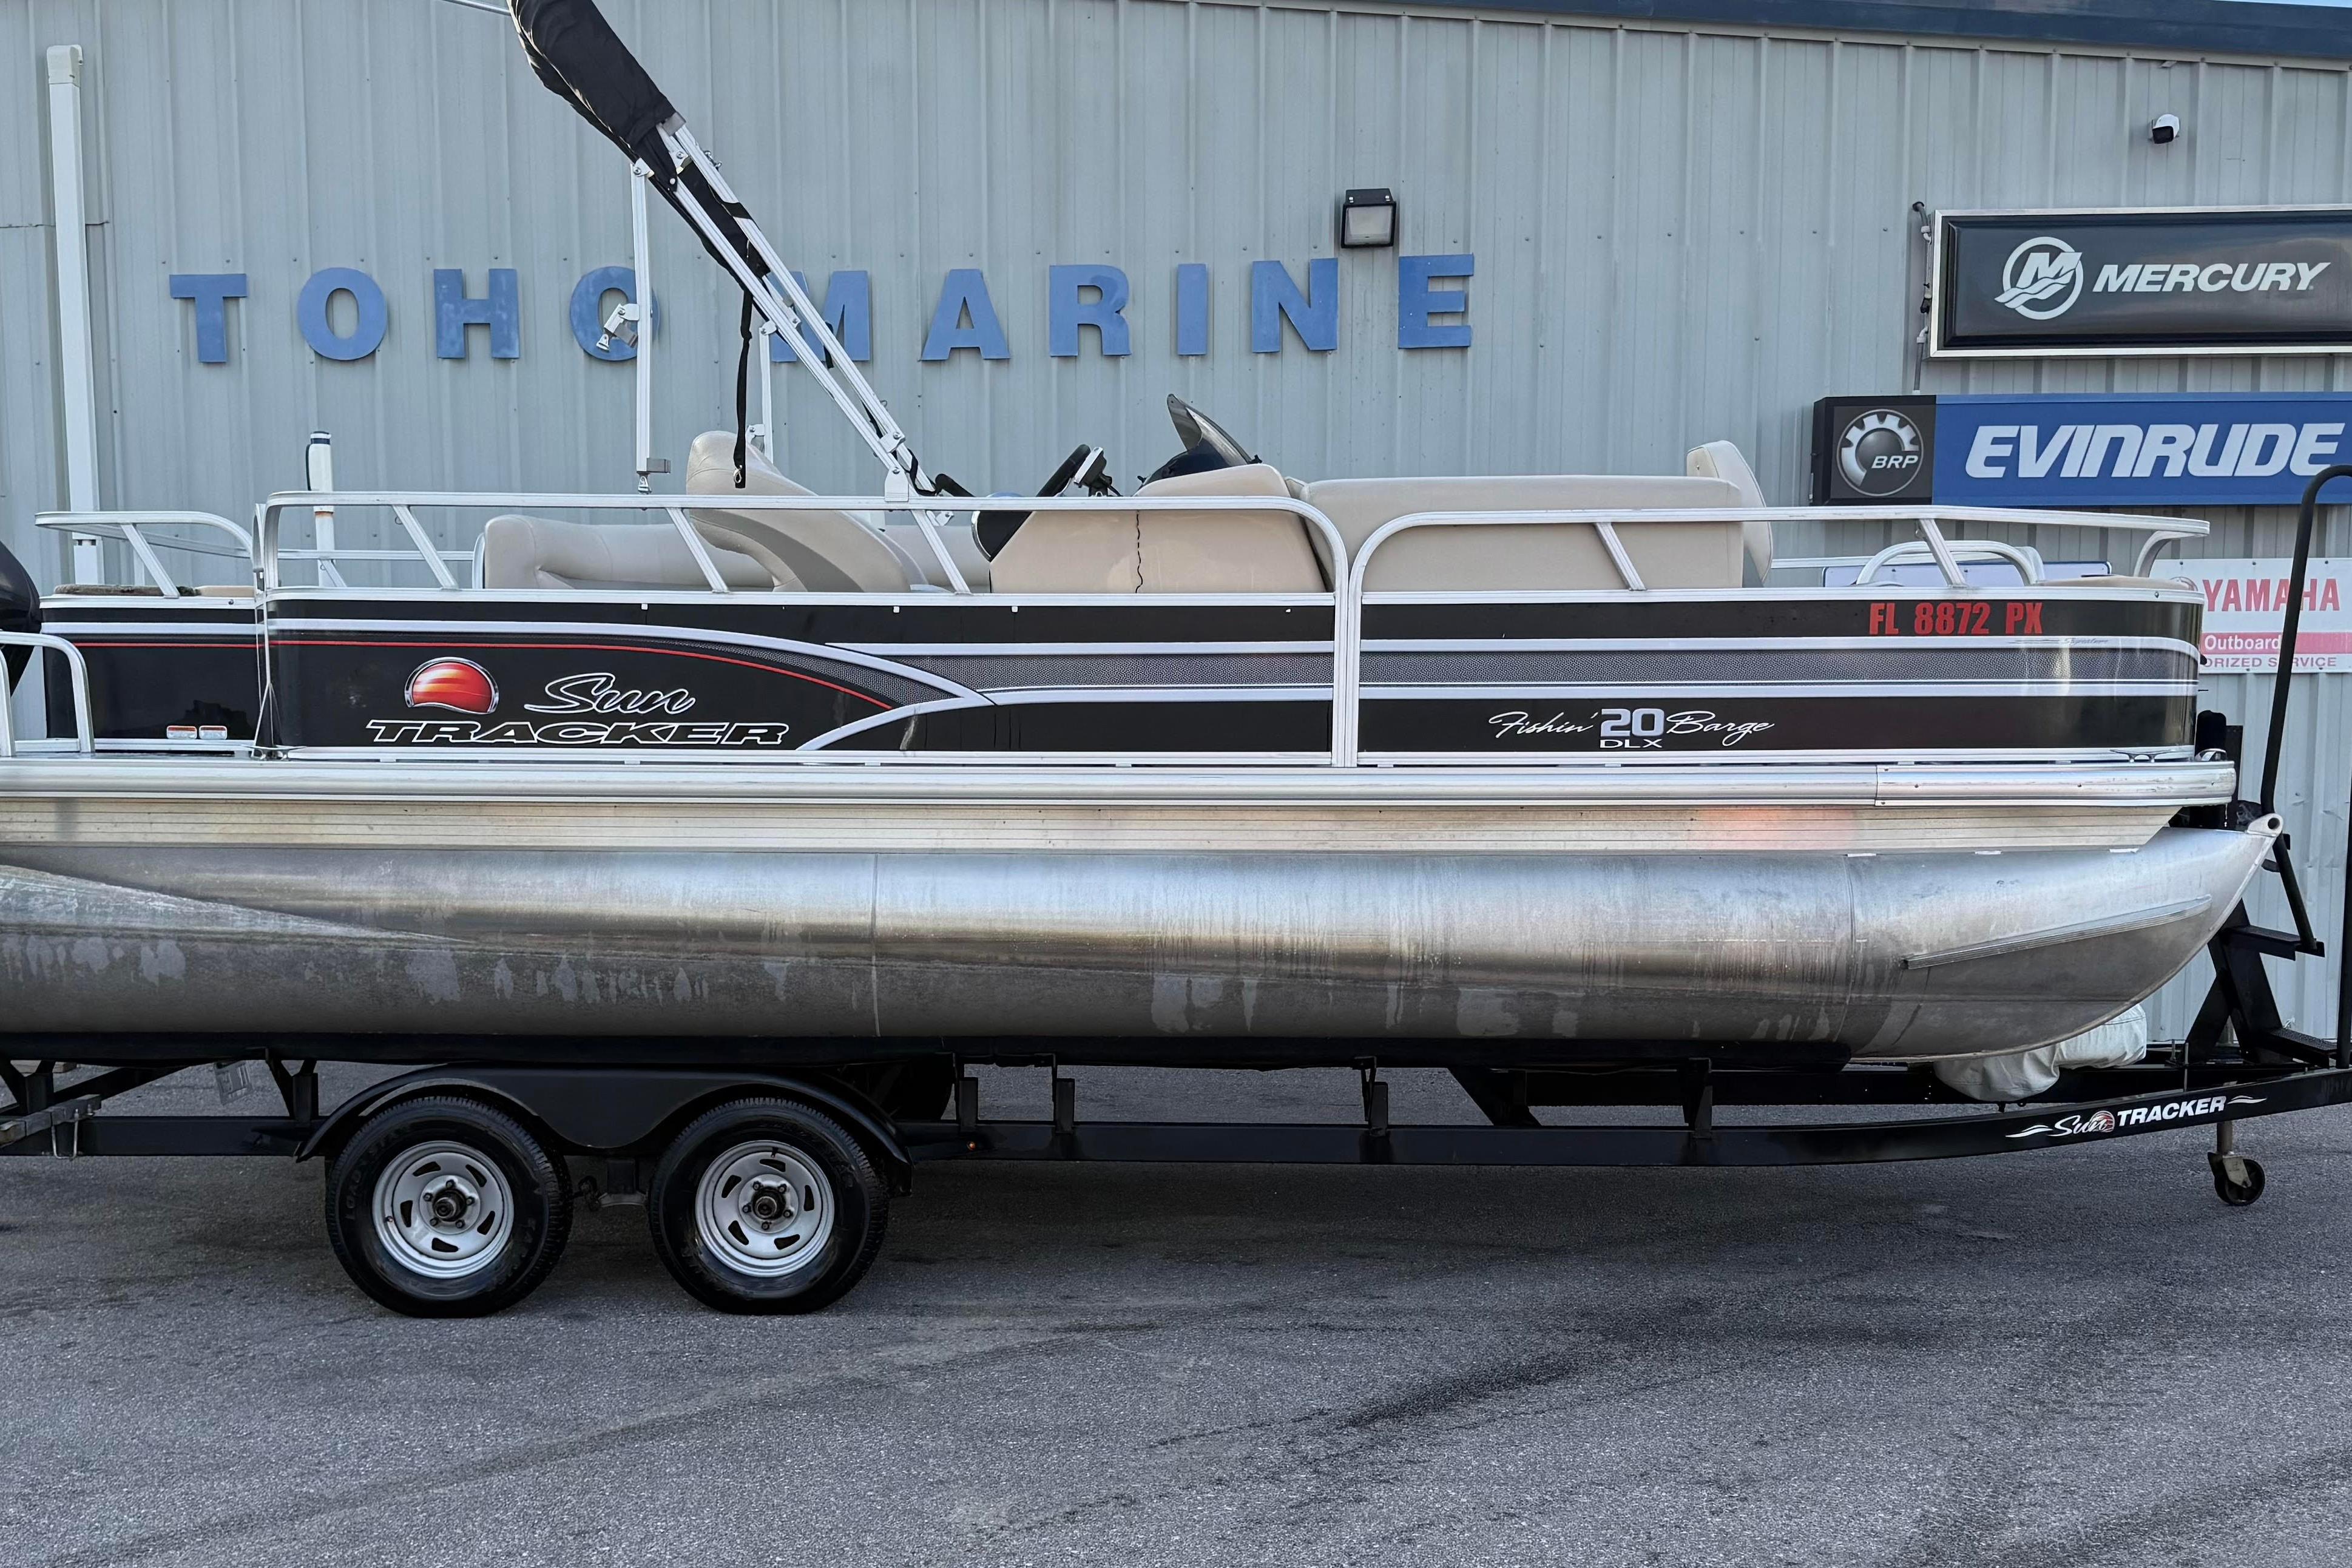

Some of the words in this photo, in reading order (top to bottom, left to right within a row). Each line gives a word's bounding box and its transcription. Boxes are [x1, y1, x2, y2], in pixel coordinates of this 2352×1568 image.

[2092, 262, 2331, 292] MERCURY
[169, 266, 660, 363] TOHO
[771, 253, 1475, 362] MARINE
[1871, 455, 1919, 469] BRP
[1965, 423, 2346, 479] EVINRUDE
[2202, 578, 2340, 612] YAMAHA
[1869, 603, 1900, 635] FL
[1914, 602, 1992, 635] 8872
[2005, 602, 2043, 634] PX
[2204, 634, 2282, 651] Outboard
[2268, 657, 2337, 667] SRVICE
[524, 672, 696, 715] Sun
[365, 720, 789, 745] TRACKER
[1600, 738, 1663, 748] DLX
[1601, 708, 1664, 737] 20
[1665, 711, 1774, 746] Barge
[2046, 1115, 2108, 1137] Sun
[2117, 1095, 2227, 1127] TRACKER
